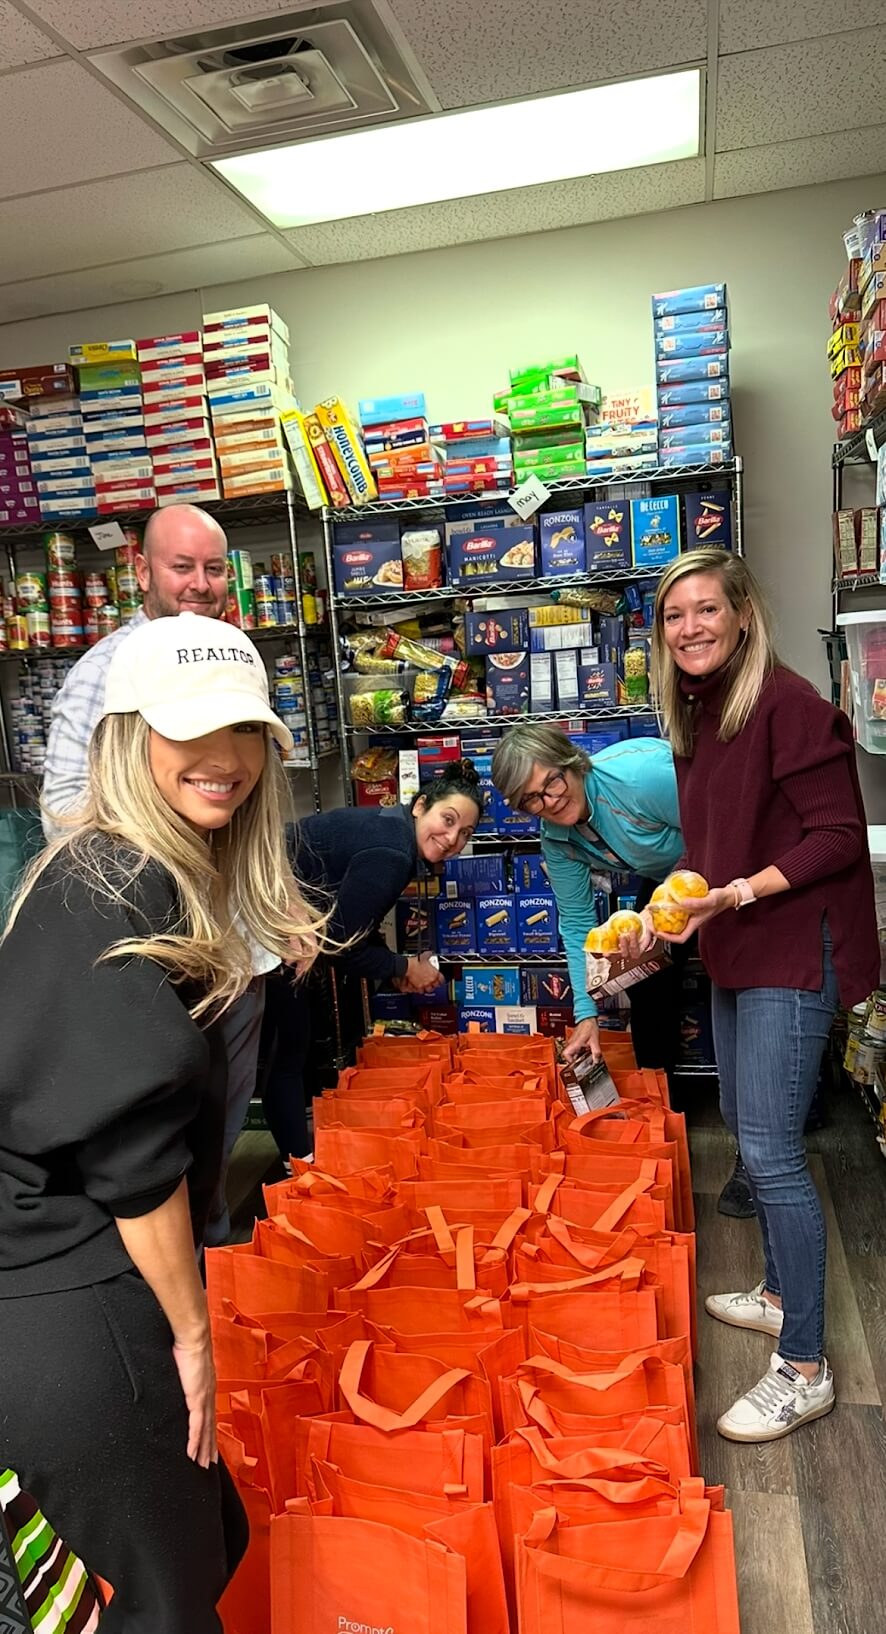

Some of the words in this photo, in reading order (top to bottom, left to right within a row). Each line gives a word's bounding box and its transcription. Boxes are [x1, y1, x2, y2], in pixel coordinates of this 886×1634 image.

[543, 514, 580, 527] RONZONI
[467, 540, 493, 550] Barilla
[345, 553, 370, 563] Barilla
[439, 901, 471, 911] RONZONI
[479, 899, 513, 909] RONZONI
[519, 898, 553, 908] RONZONI
[461, 1010, 493, 1019] RONZONI
